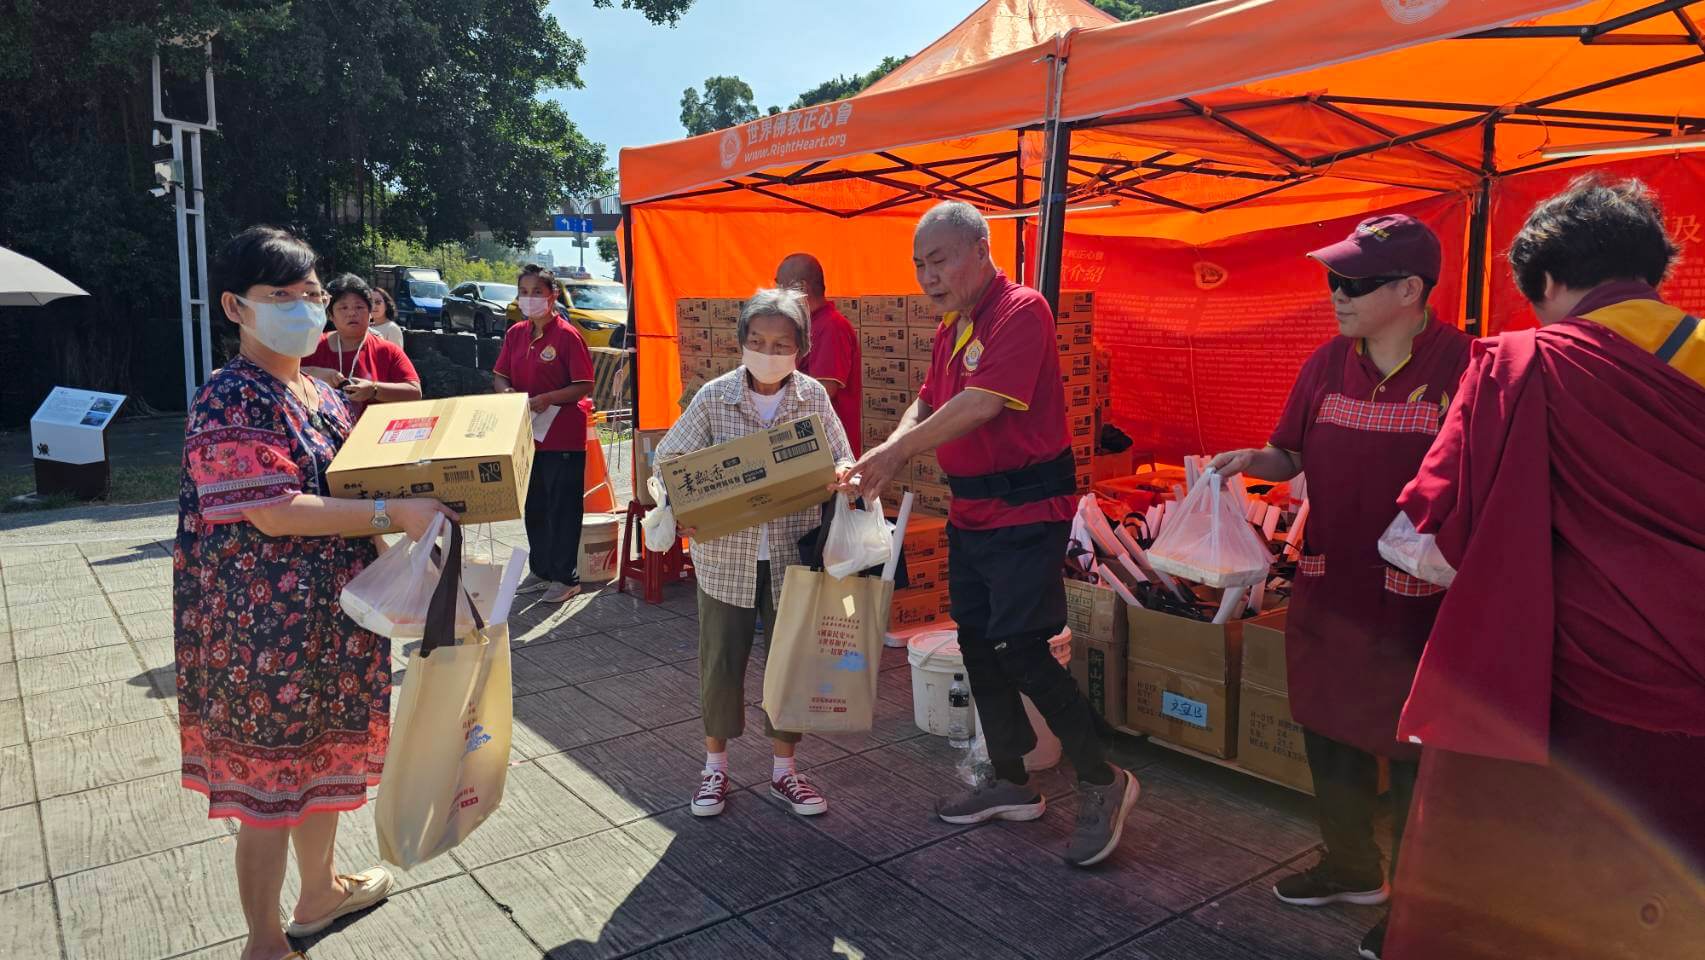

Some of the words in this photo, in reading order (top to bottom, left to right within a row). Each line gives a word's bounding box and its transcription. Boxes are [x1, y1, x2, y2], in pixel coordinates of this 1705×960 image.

[747, 102, 853, 145] 世界佛教正心會
[744, 133, 847, 163] www.RightHeart.org
[488, 463, 500, 473] 10
